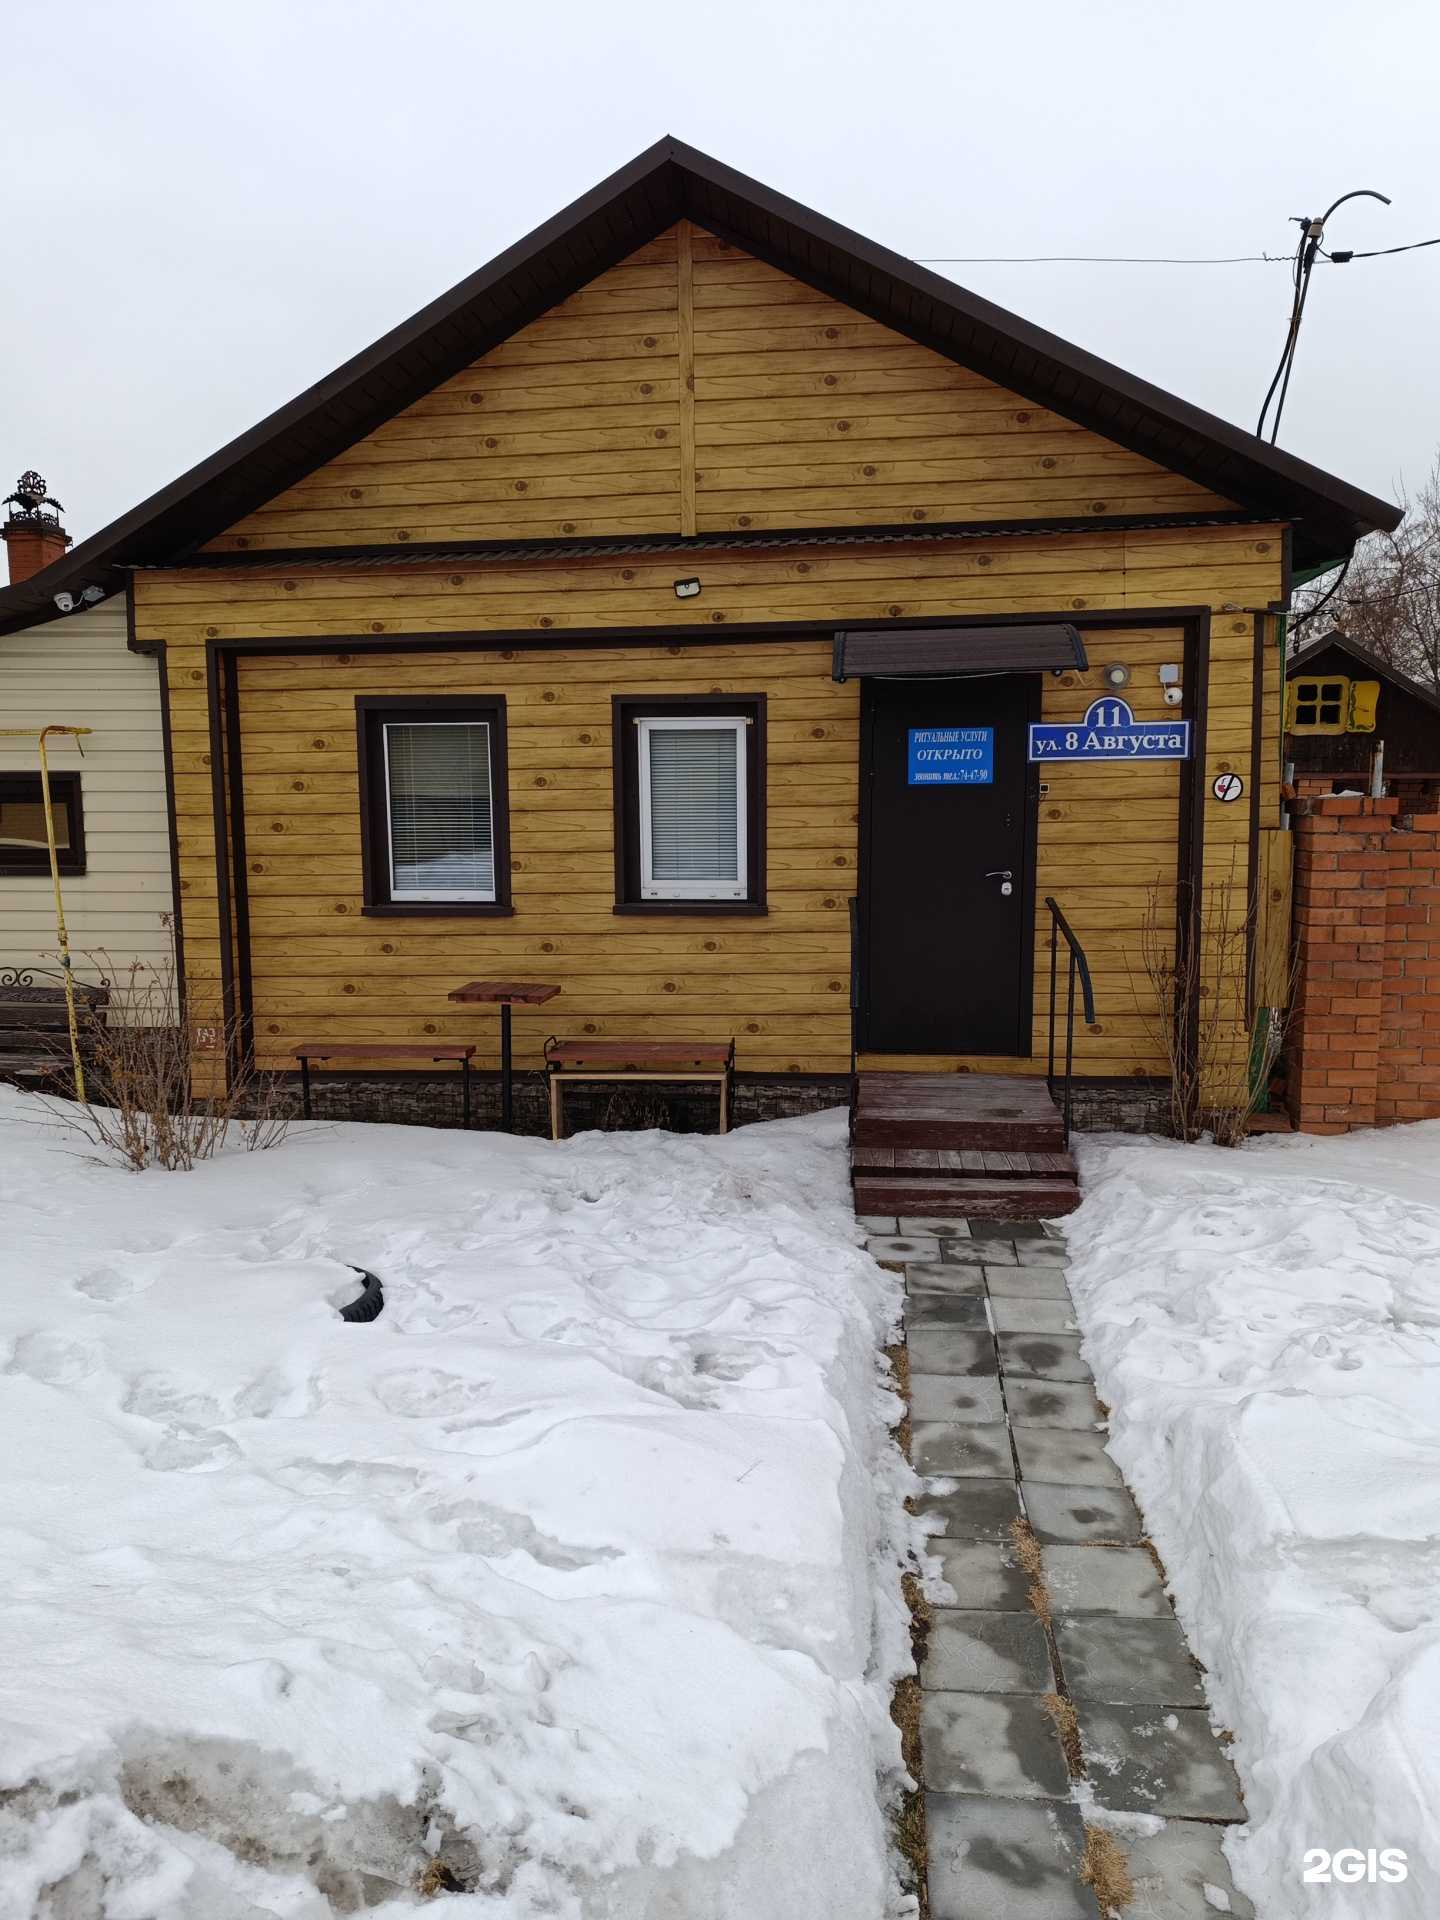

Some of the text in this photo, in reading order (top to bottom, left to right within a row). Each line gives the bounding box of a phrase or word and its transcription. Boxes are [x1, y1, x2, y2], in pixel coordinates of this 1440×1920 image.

[1096, 707, 1121, 727] 11
[914, 730, 987, 743] РИТУАЛЬНЫЕ УСЛУГИ
[1036, 732, 1182, 754] ул. 8 Августа
[917, 748, 983, 761] ОТКРЫТО
